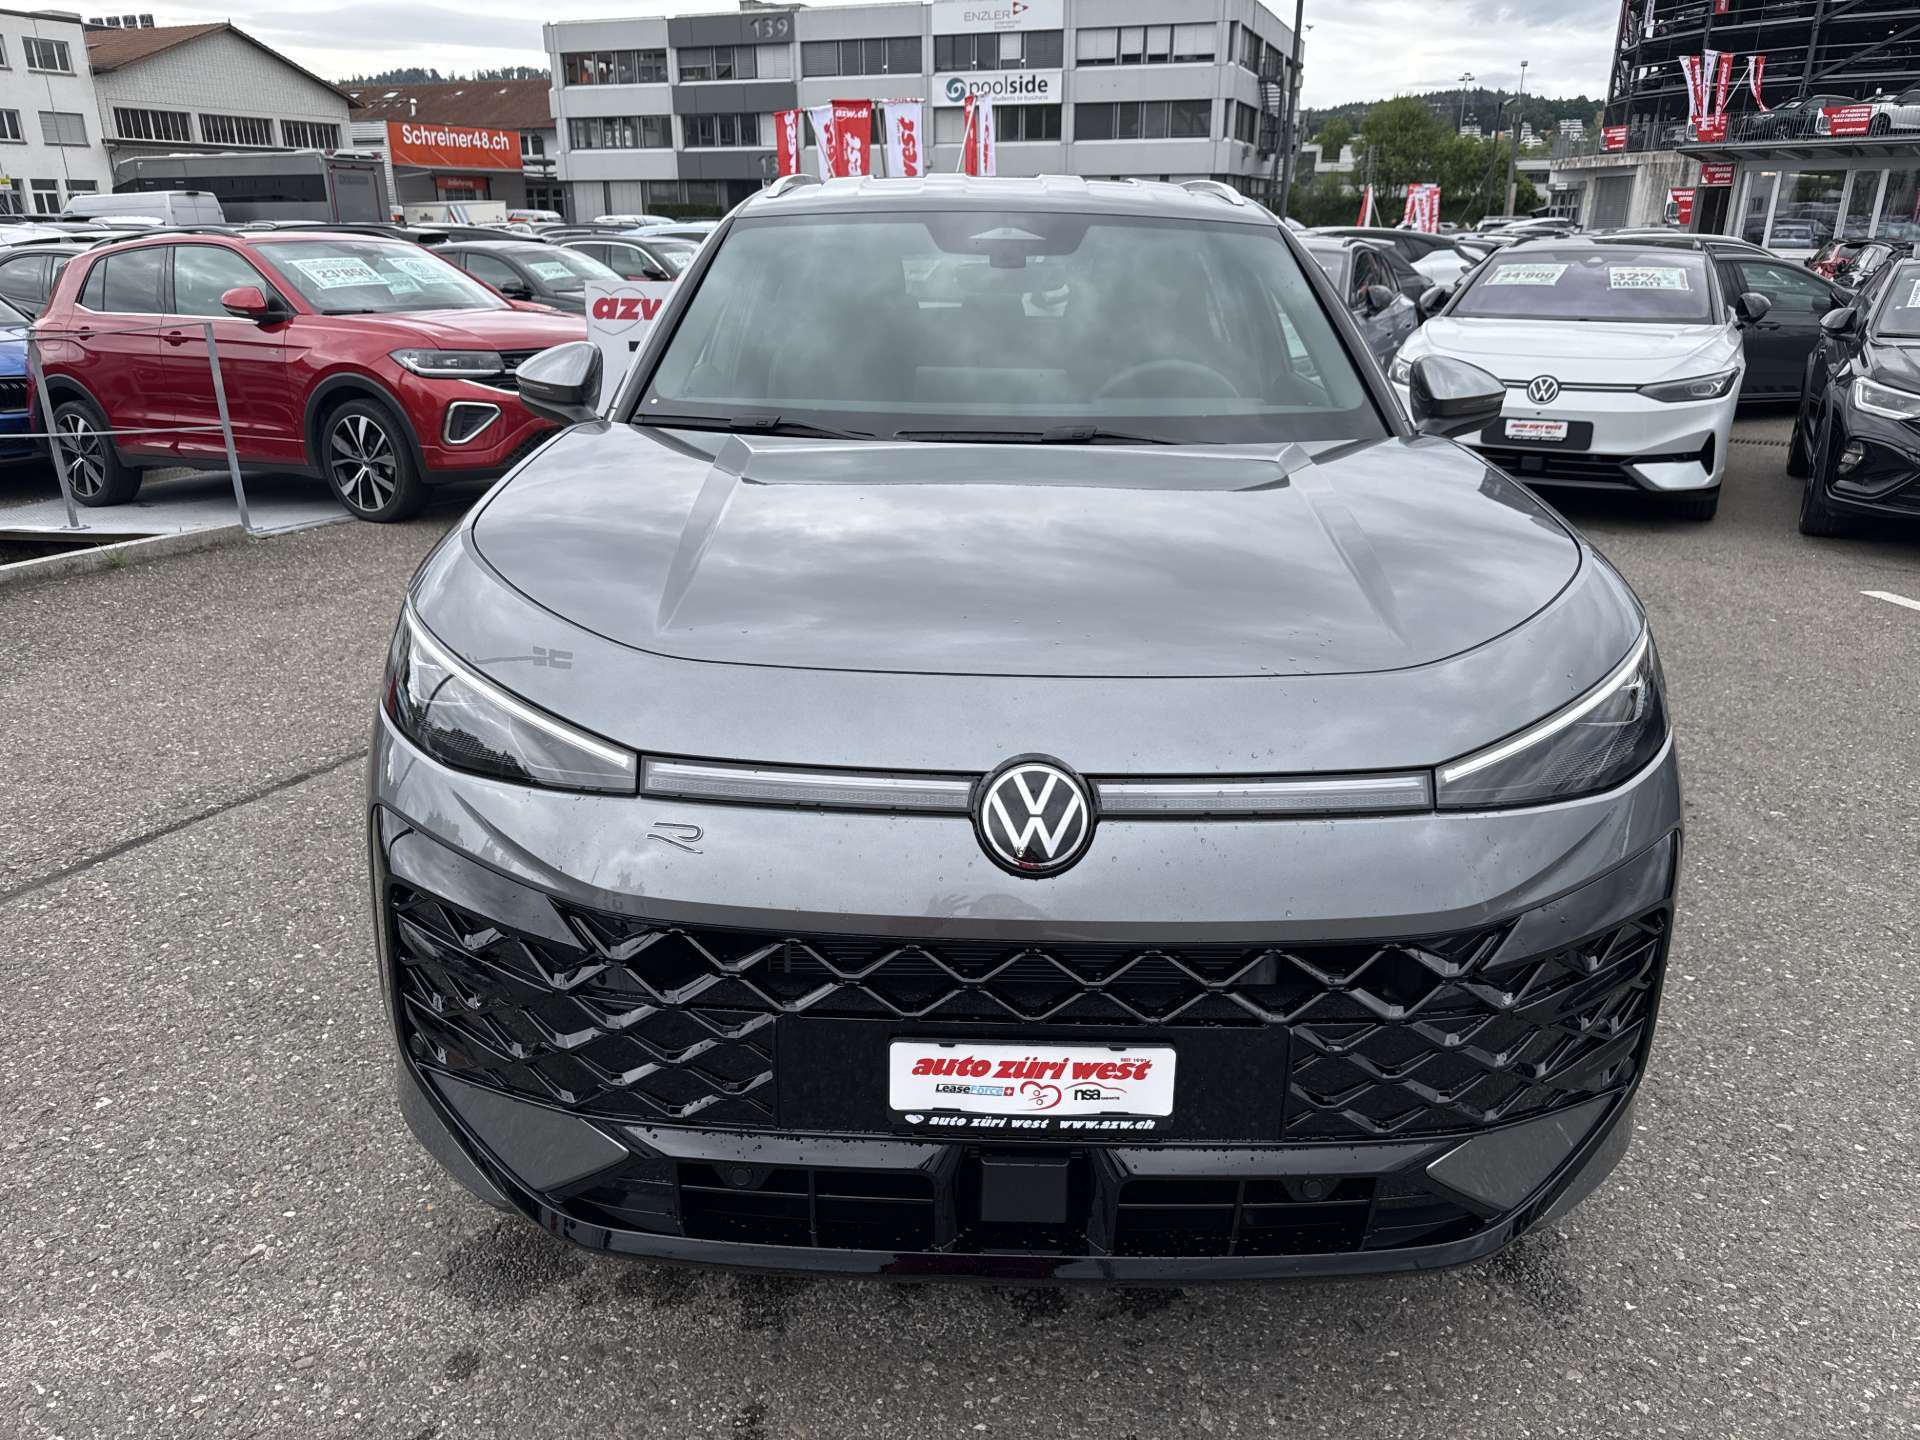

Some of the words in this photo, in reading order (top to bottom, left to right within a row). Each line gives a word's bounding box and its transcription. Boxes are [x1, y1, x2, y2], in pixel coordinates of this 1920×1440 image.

[963, 10, 1010, 22] ENZLER
[751, 17, 789, 38] 139
[969, 74, 1049, 95] poolside
[835, 108, 868, 119] azw.ch
[402, 124, 510, 151] Schreiner48.ch
[845, 132, 862, 176] est
[1501, 271, 1556, 280] 44'800
[1612, 271, 1662, 282] 32%
[911, 1055, 992, 1077] auto
[992, 1057, 1070, 1080] züri
[1072, 1060, 1153, 1081] west
[935, 1082, 1004, 1097] LeaseForce
[1074, 1088, 1101, 1101] nsa
[929, 1115, 967, 1128] auto
[971, 1115, 1007, 1128] züri
[1011, 1117, 1049, 1129] west
[1059, 1118, 1156, 1131] www.azw.ch
